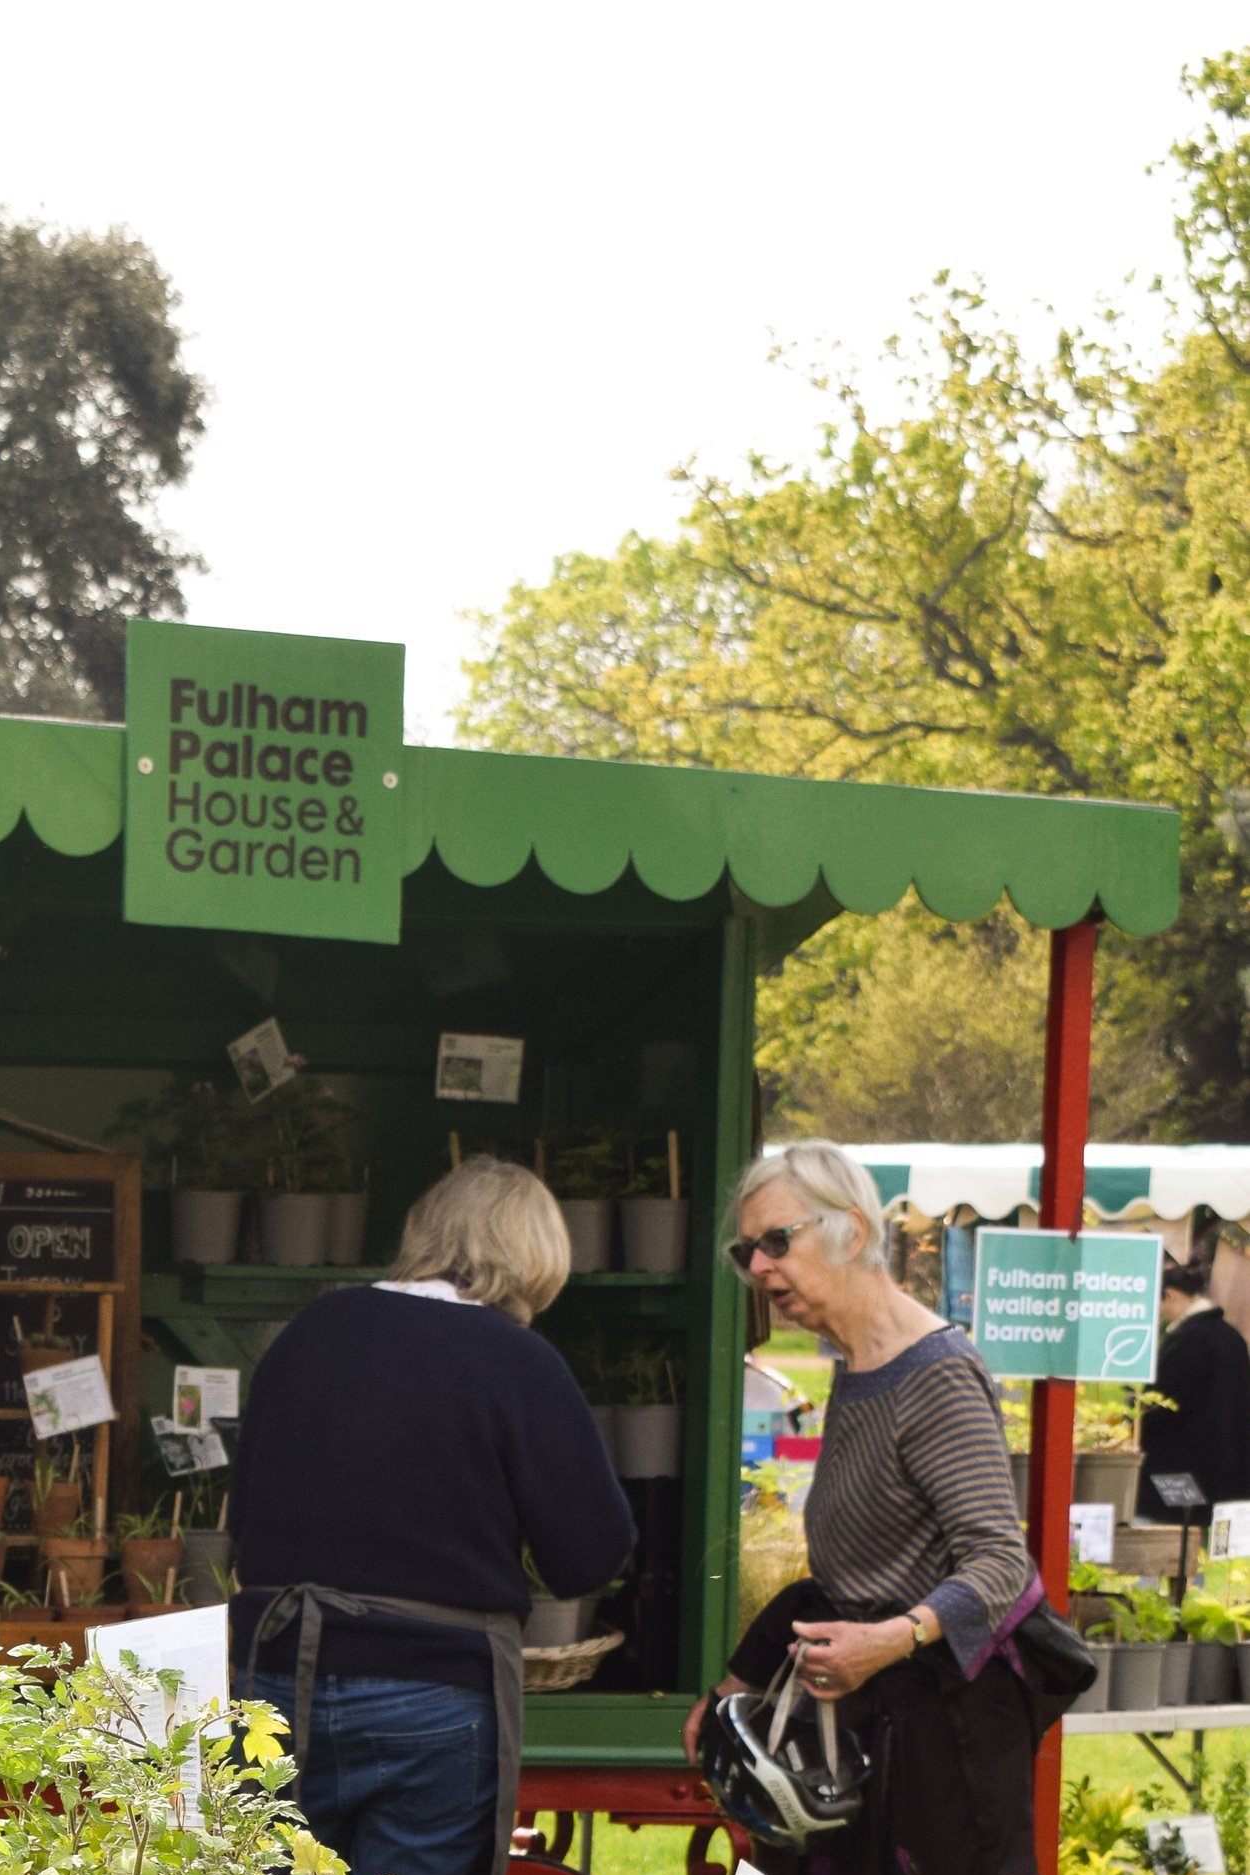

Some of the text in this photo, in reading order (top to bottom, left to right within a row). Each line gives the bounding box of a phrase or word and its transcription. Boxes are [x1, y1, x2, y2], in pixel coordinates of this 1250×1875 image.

[170, 678, 367, 738] Fulham
[169, 730, 354, 787] Palace
[165, 828, 361, 883] Garden
[7, 1224, 91, 1260] OPEN
[987, 1268, 1147, 1292] Fulham Palace
[985, 1296, 1147, 1321] walled garden
[984, 1322, 1066, 1343] barrow
